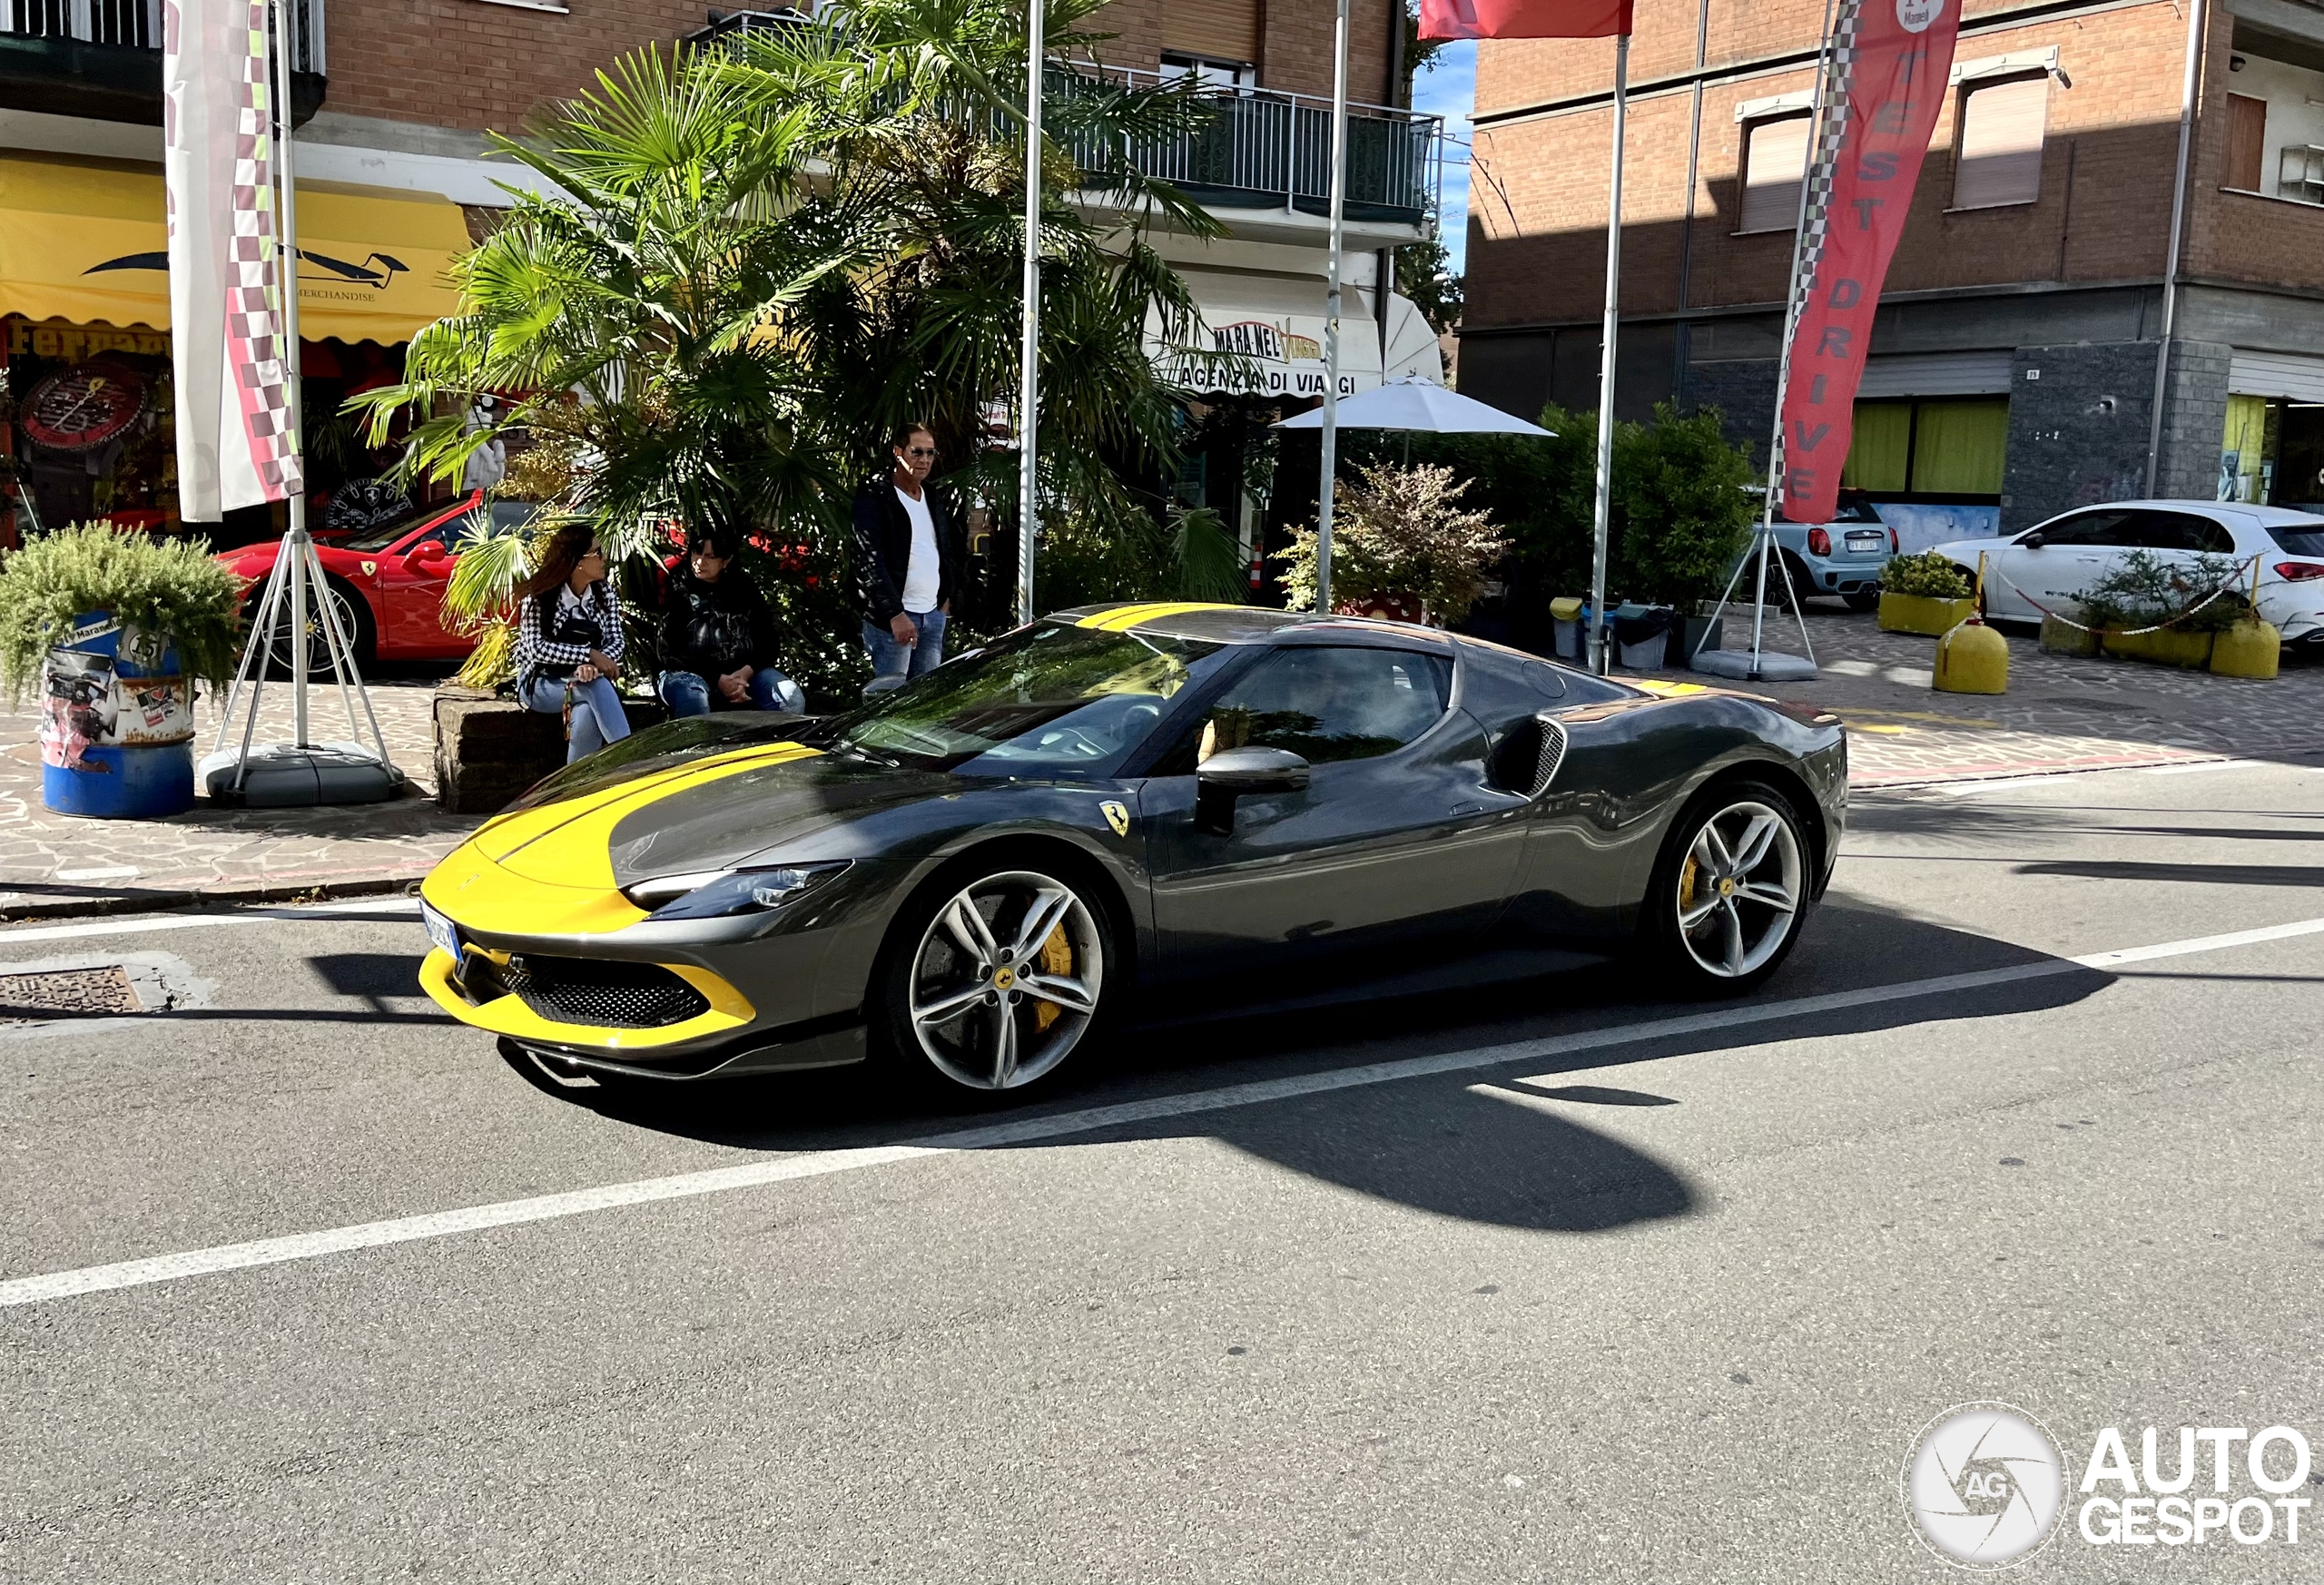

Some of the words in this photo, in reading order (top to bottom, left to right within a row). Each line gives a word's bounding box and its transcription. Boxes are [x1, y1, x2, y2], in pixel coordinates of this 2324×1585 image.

[1850, 50, 1927, 231] TEST
[1270, 372, 1287, 390] DI
[1296, 373, 1354, 394] VIAGI
[1788, 278, 1862, 499] DRIVE
